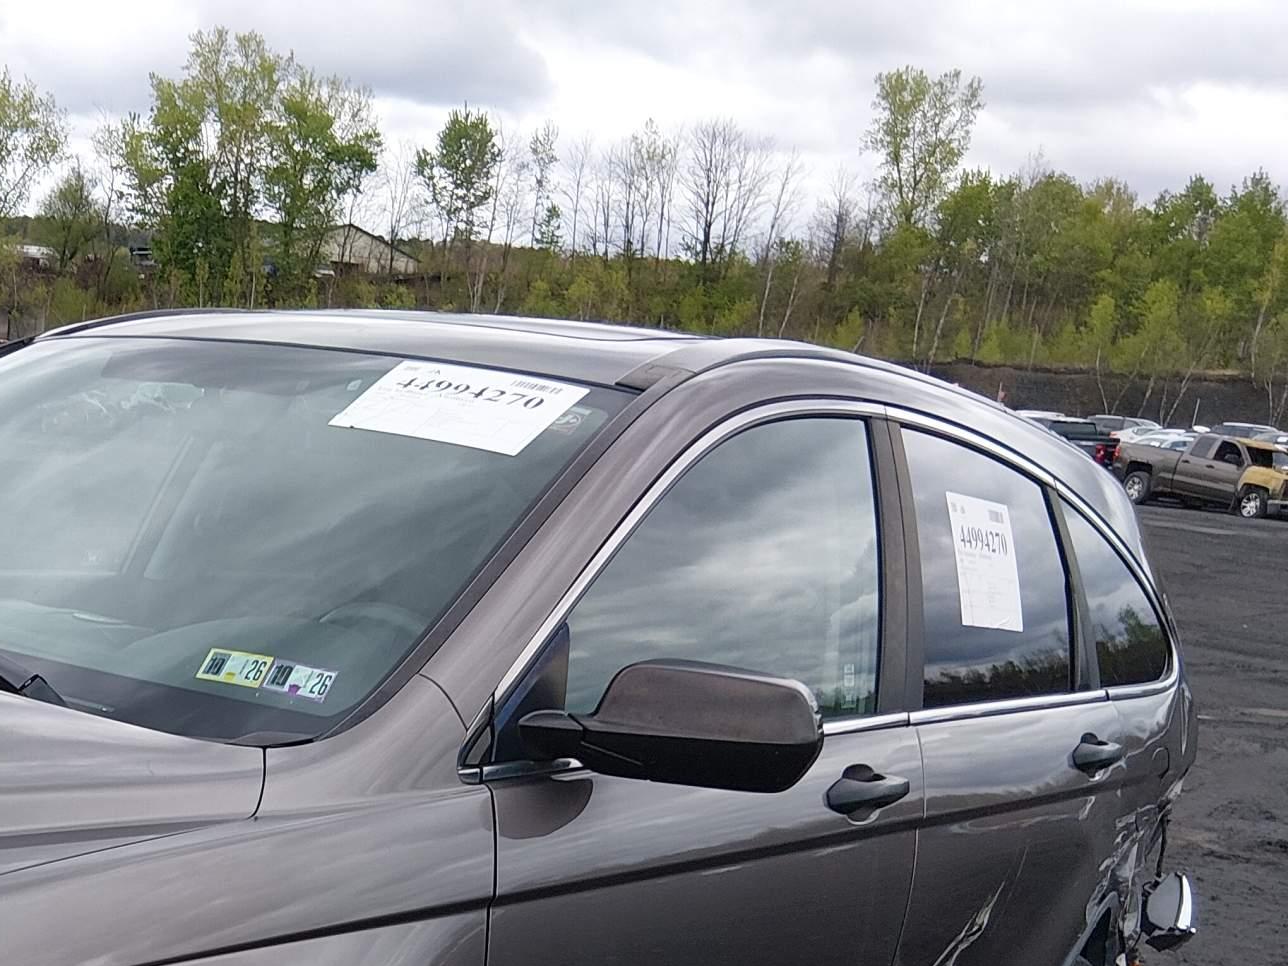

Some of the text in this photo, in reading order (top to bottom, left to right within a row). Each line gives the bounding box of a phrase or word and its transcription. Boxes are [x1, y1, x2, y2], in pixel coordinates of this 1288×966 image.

[396, 376, 545, 410] 44994270
[960, 525, 1008, 557] 44994270
[245, 660, 267, 681] 26
[309, 672, 333, 696] 26
